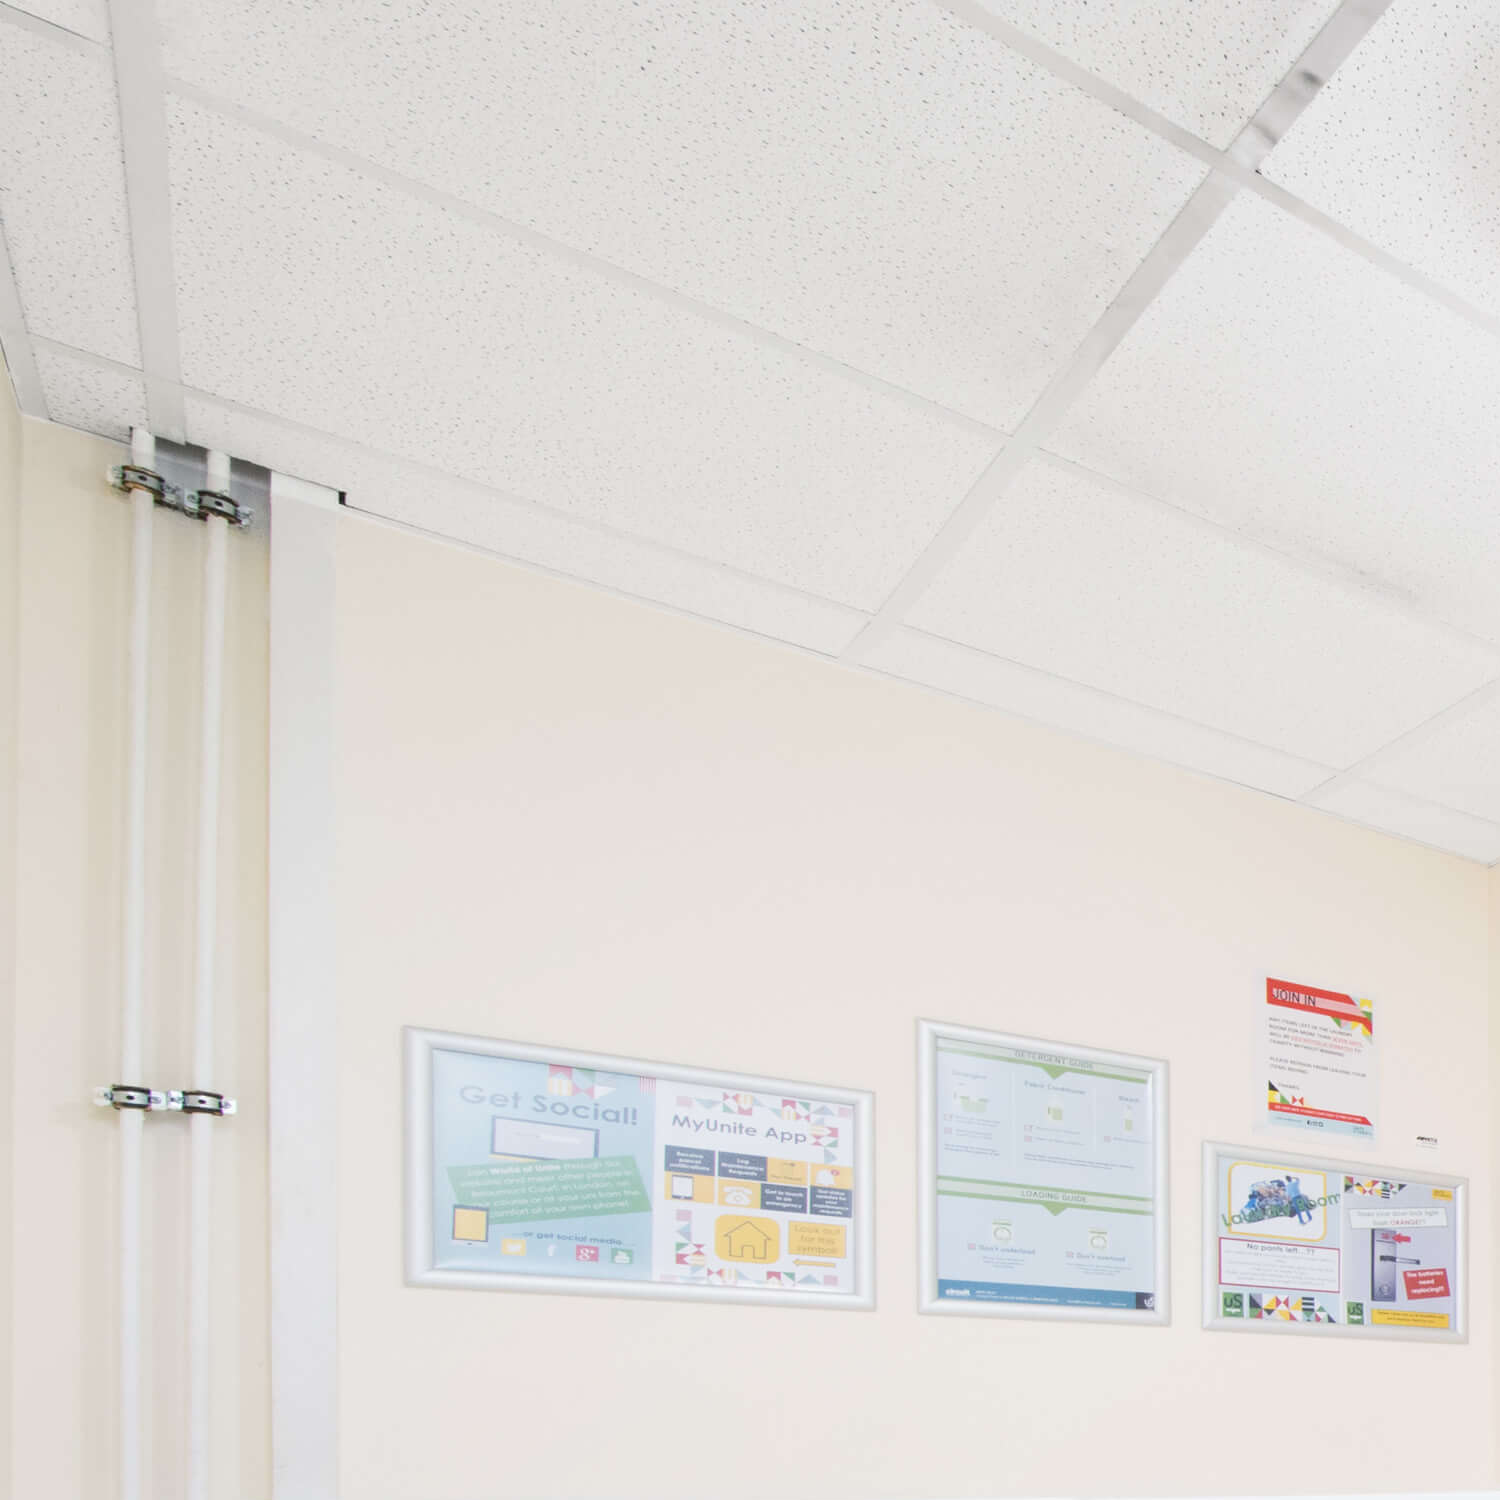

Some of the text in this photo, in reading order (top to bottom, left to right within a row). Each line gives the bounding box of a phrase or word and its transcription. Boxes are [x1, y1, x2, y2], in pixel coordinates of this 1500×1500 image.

[1272, 988, 1316, 1006] JOIN IN
[460, 1086, 637, 1125] Get Social!
[672, 1114, 807, 1144] MyUnite App
